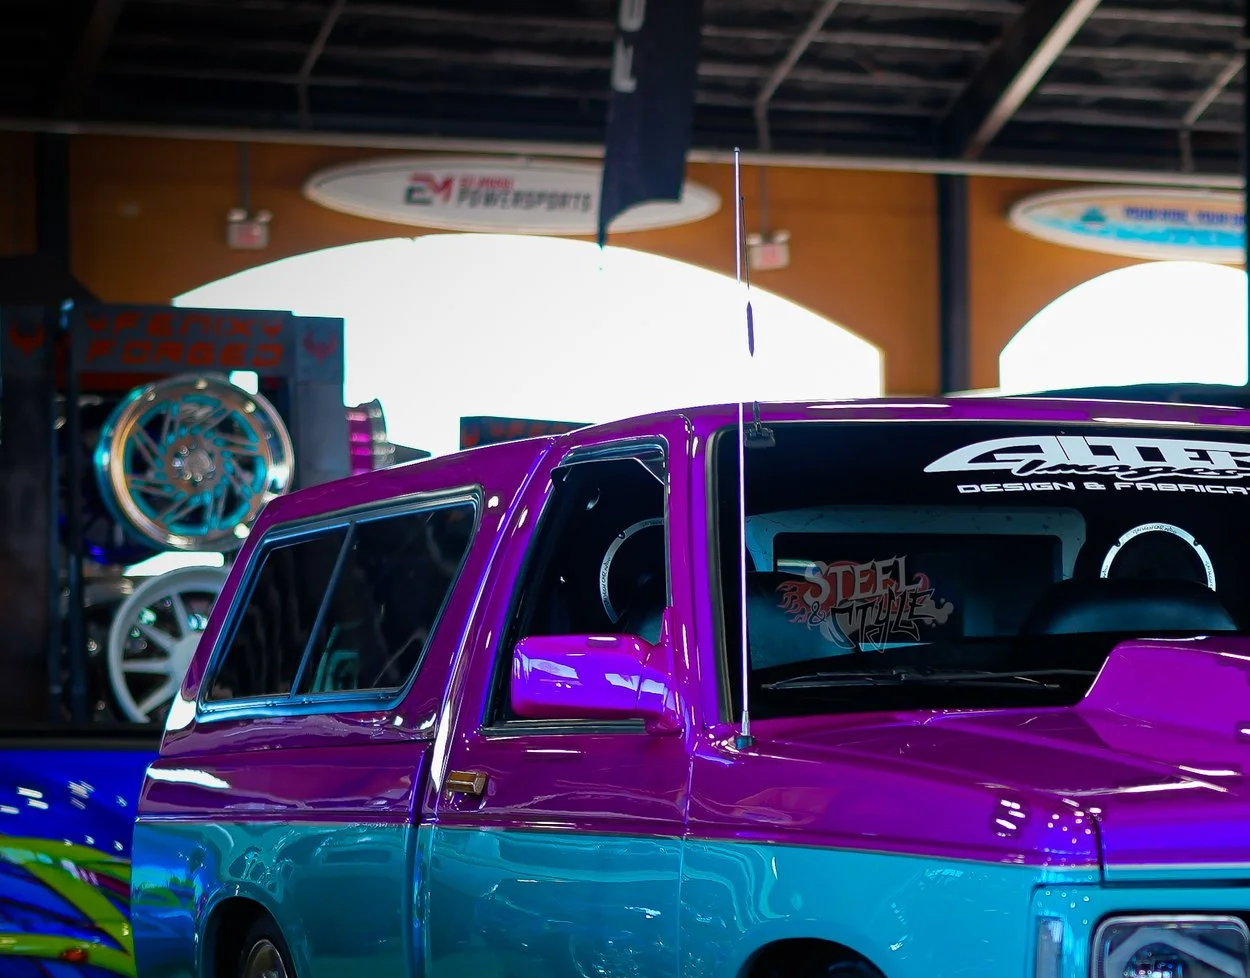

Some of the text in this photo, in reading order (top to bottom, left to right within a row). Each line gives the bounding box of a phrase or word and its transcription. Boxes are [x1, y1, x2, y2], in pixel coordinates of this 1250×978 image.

[113, 312, 255, 338] FENIX
[86, 339, 283, 367] FORGED
[957, 481, 1076, 494] DESIGN
[803, 554, 922, 605] STEEL
